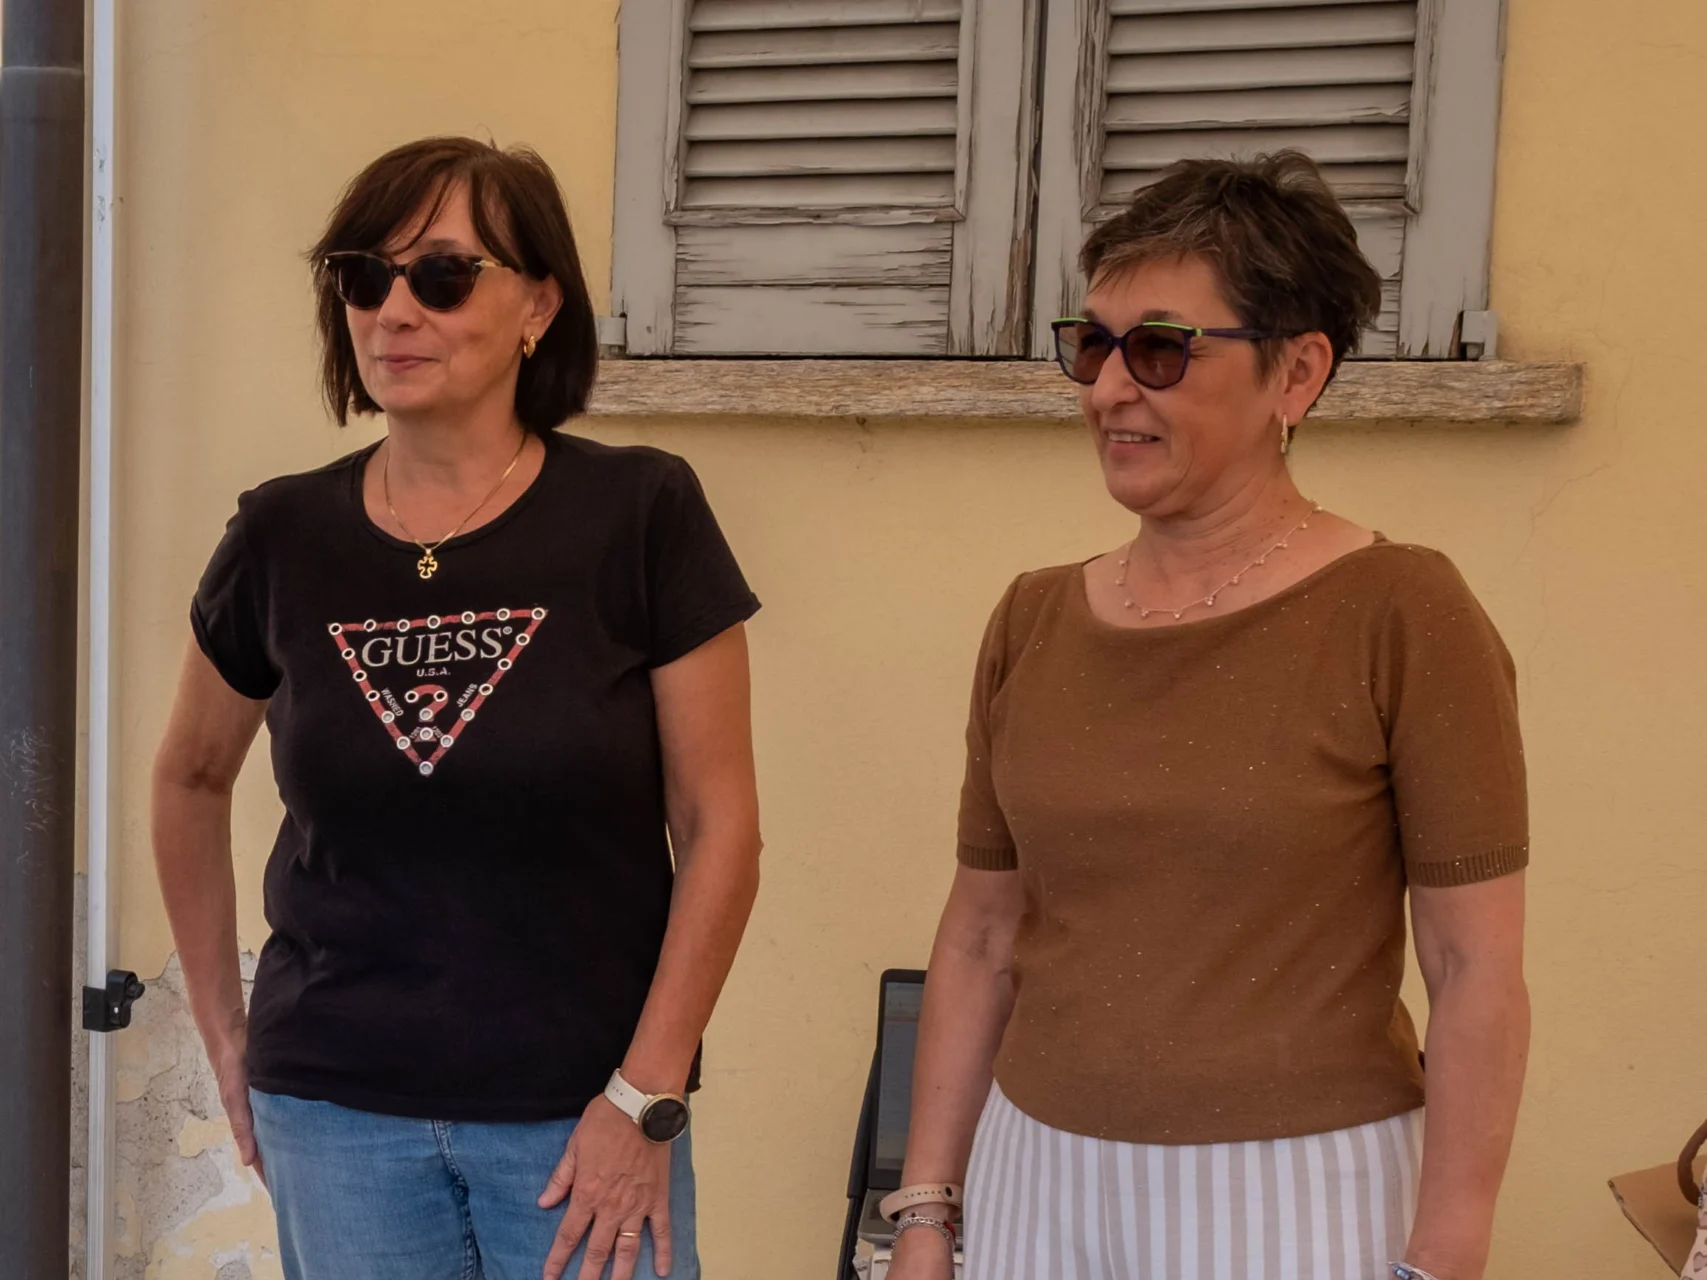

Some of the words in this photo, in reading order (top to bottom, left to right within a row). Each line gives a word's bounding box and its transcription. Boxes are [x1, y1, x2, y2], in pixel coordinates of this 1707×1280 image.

[416, 666, 452, 678] U.S.A.
[380, 686, 405, 717] WASHED
[456, 683, 479, 708] JEANS
